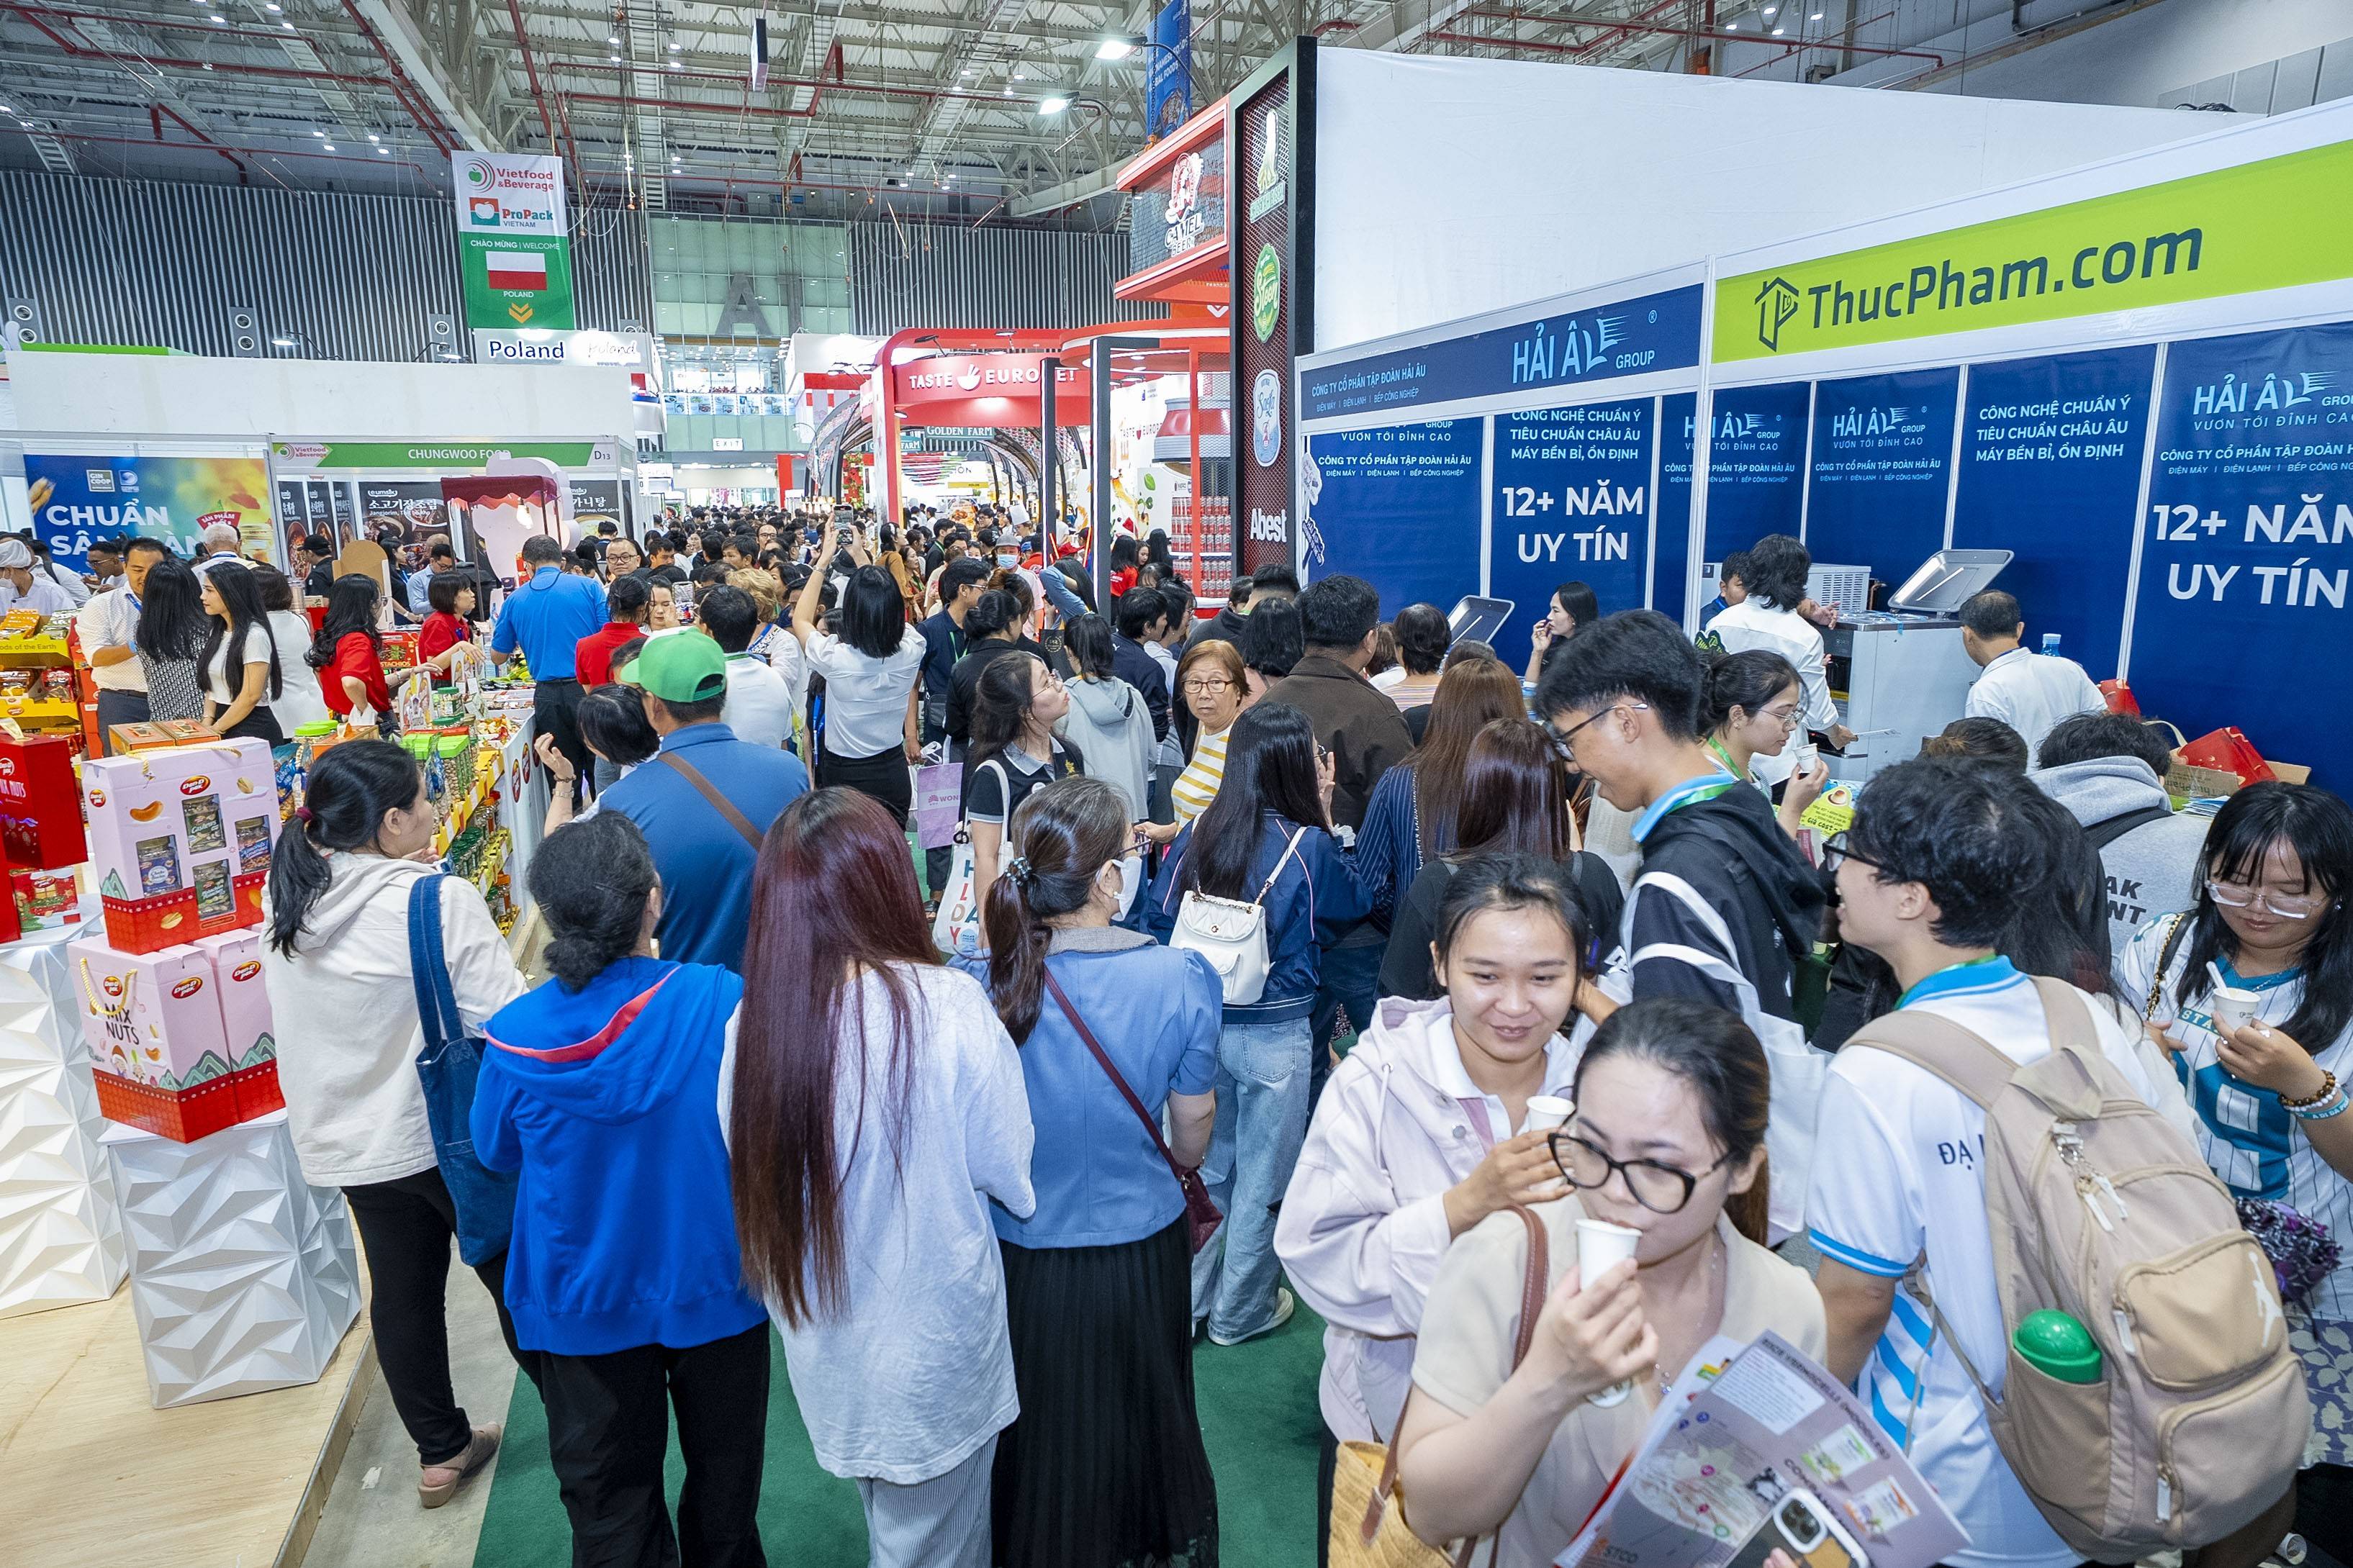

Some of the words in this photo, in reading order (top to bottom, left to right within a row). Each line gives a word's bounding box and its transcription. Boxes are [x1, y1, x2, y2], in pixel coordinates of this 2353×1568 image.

[497, 168, 554, 180] Vietfood
[497, 179, 554, 191] &Beverage
[502, 209, 554, 220] ProPack
[1166, 215, 1202, 245] CAMEL
[494, 240, 518, 248] MỪNG
[1172, 238, 1192, 255] BEER
[1808, 227, 2202, 329] ThucPham.com
[490, 340, 564, 358] Poland
[1512, 322, 1555, 384] HẢI
[1615, 350, 1655, 369] GROUP
[909, 373, 953, 389] TASTE
[985, 368, 1075, 384] EUROE!
[1312, 384, 1328, 397] CÔNG
[1329, 382, 1337, 393] TY
[1338, 374, 1347, 392] CỔ
[1367, 371, 1380, 389] TẬP
[1381, 367, 1400, 384] ĐOÀN
[1401, 363, 1414, 380] HẢI
[1416, 363, 1426, 378] ÂU
[2193, 373, 2248, 415] HẢI
[1551, 408, 1585, 423] NGHỆ
[1588, 407, 1631, 422] CHUẨN
[1632, 409, 1641, 421] Ý
[1979, 405, 2017, 420] CÔNG
[2020, 400, 2059, 418] NGHỆ
[2062, 395, 2116, 414] CHUẨN
[2121, 394, 2131, 411] Ý
[926, 426, 964, 435] GOLDEN
[967, 427, 993, 436] FARM
[1684, 416, 1716, 438] HI
[1833, 407, 1863, 437] HẢI
[1901, 425, 1925, 433] GROUP
[1977, 425, 2005, 441] TIÊU
[2007, 421, 2056, 439] CHUẨN
[2060, 420, 2103, 437] CHÂU
[2105, 419, 2129, 434] ÂU
[2194, 418, 2235, 431] VƯƠN
[2243, 415, 2267, 428] TỚI
[2276, 412, 2318, 426] ĐỈNH
[1342, 432, 1371, 442] VƯƠN
[1376, 432, 1394, 442] TỚI
[1399, 430, 1424, 441] ĐỈNH
[1430, 432, 1451, 442] CAO
[1510, 427, 1538, 440] TIÊU
[1541, 426, 1584, 440] CHUẨN
[1588, 427, 1620, 440] CHÂU
[1623, 427, 1640, 440] ÂU
[1904, 437, 1923, 446] CAO
[408, 449, 477, 460] CHUNGWOO
[901, 440, 921, 450] FARM
[1512, 445, 1538, 459] MÁY
[1542, 445, 1567, 459] BỀN
[1588, 445, 1606, 459] ỔN
[1609, 449, 1638, 461] ĐỊNH
[1976, 446, 2005, 461] MÁY
[2007, 444, 2034, 461] BỀN
[2059, 442, 2081, 458] ỔN
[2084, 443, 2124, 461] ĐỊNH
[2160, 449, 2194, 461] CÔNG
[2197, 450, 2213, 460] TY
[2216, 444, 2234, 459] CỔ
[2275, 444, 2300, 458] TẬP
[2304, 442, 2344, 456] ĐOÀN
[594, 450, 610, 460] D13
[1318, 455, 1345, 466] CÔNG
[1346, 456, 1358, 465] TY
[1360, 453, 1373, 465] CỔ
[1400, 455, 1417, 466] TẬP
[1419, 453, 1442, 465] ĐOÀN
[1444, 453, 1458, 465] HẢI
[1460, 454, 1471, 464] ÂU
[1815, 463, 1834, 471] CÔNG
[1846, 459, 1856, 470] CỔ
[1930, 458, 1941, 468] ÂU
[1326, 468, 1342, 477] ĐIỆN
[1367, 468, 1384, 477] ĐIỆN
[1441, 468, 1464, 477] NGHIỆP
[1665, 463, 1686, 472] CÔNG
[2169, 466, 2187, 475] ĐIỆN
[2190, 466, 2208, 474] MÁY
[2223, 463, 2246, 473] ĐIỆN
[2246, 464, 2271, 473] LẠNH
[2287, 461, 2307, 472] BẾP
[2309, 462, 2339, 471] CÔNG
[369, 499, 437, 509] 소고기장조림
[573, 497, 606, 507] 가니탕
[1502, 486, 1554, 517] 12+
[1566, 479, 1643, 515] NĂM
[46, 498, 168, 525] CHUẨN
[1250, 508, 1287, 543] Abest
[2154, 504, 2226, 540] 12+
[50, 530, 109, 555] SÂ
[1518, 533, 1566, 563] UY
[1573, 525, 1628, 561] TÍN
[2168, 563, 2241, 602] UY
[2252, 557, 2349, 609] TÍN
[2105, 876, 2143, 899] AK
[2108, 900, 2146, 925] NT
[950, 926, 961, 945] Y
[2181, 1010, 2219, 1033] STA
[106, 1021, 140, 1045] NUTS
